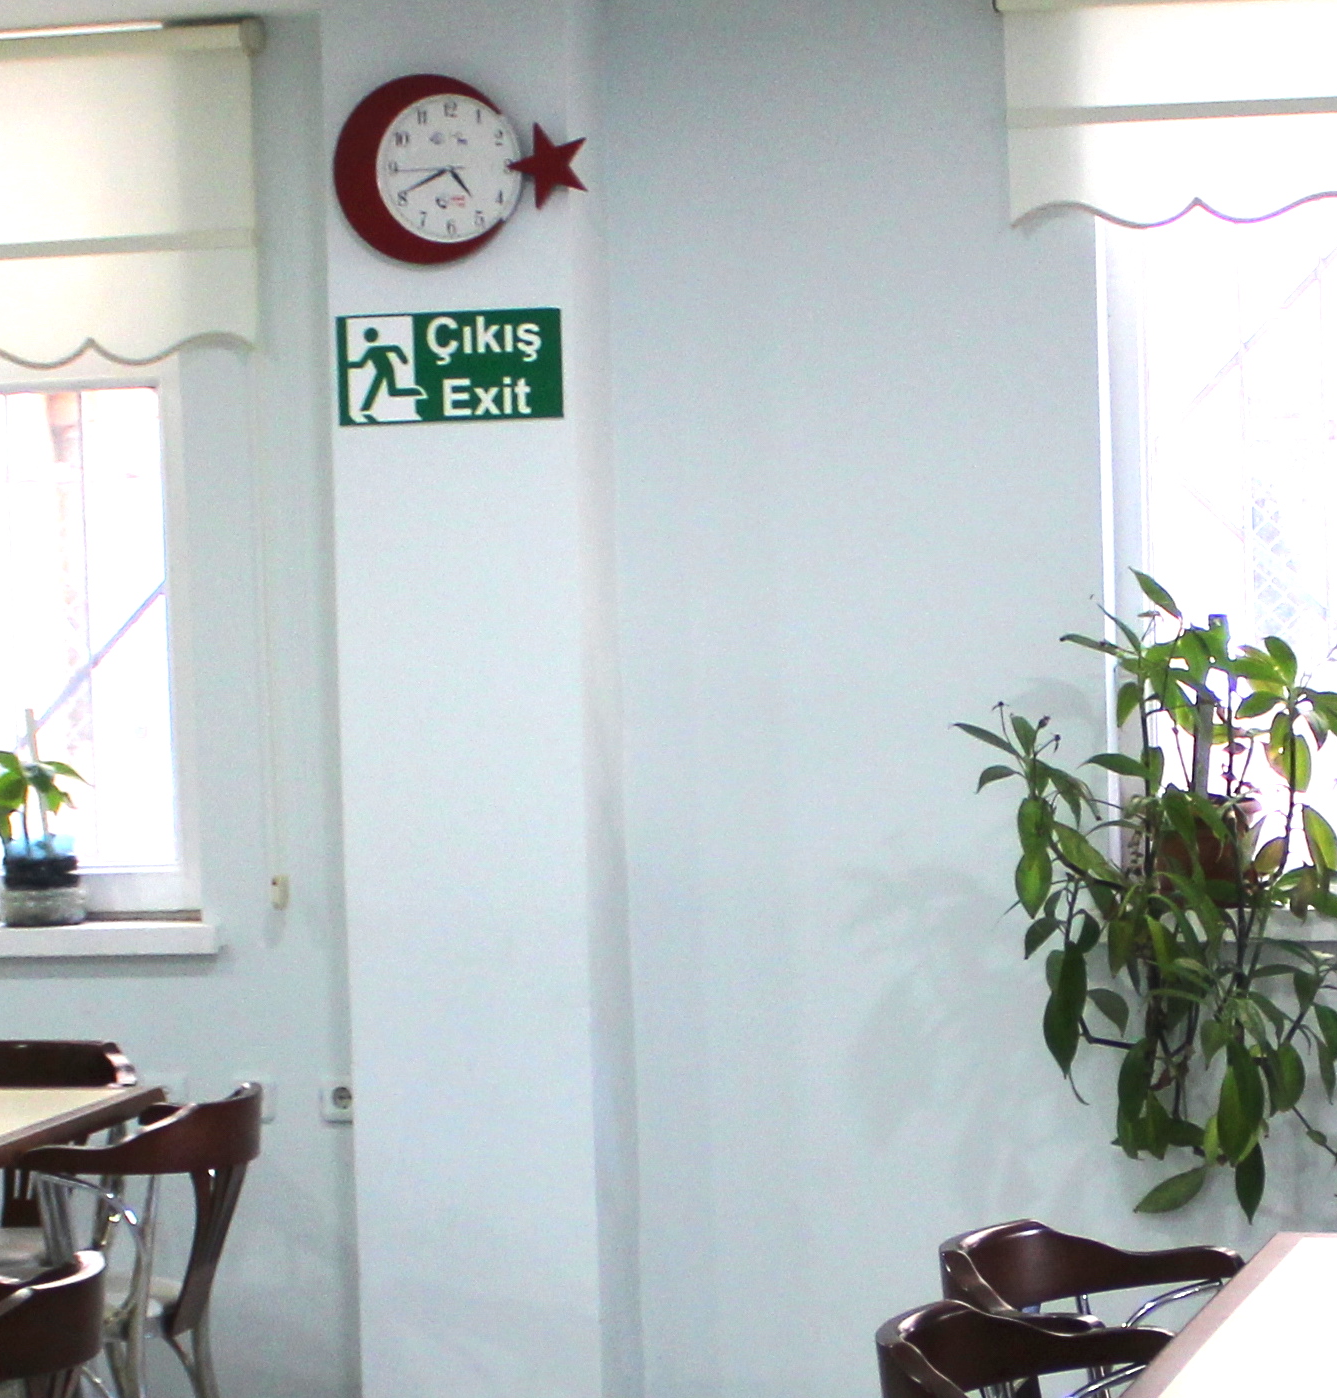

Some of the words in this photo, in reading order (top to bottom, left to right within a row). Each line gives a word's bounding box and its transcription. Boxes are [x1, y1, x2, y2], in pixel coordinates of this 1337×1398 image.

[416, 109, 428, 125] 11
[443, 101, 458, 117] 12
[475, 108, 482, 124] 1
[394, 131, 410, 146] 10
[494, 129, 504, 146] 2
[388, 161, 398, 174] 9
[397, 191, 408, 207] 8
[495, 190, 504, 205] 4
[419, 210, 428, 228] 7
[446, 219, 457, 235] 6
[474, 210, 485, 228] 5
[426, 315, 542, 365] Çıkış
[442, 376, 532, 416] Exit
